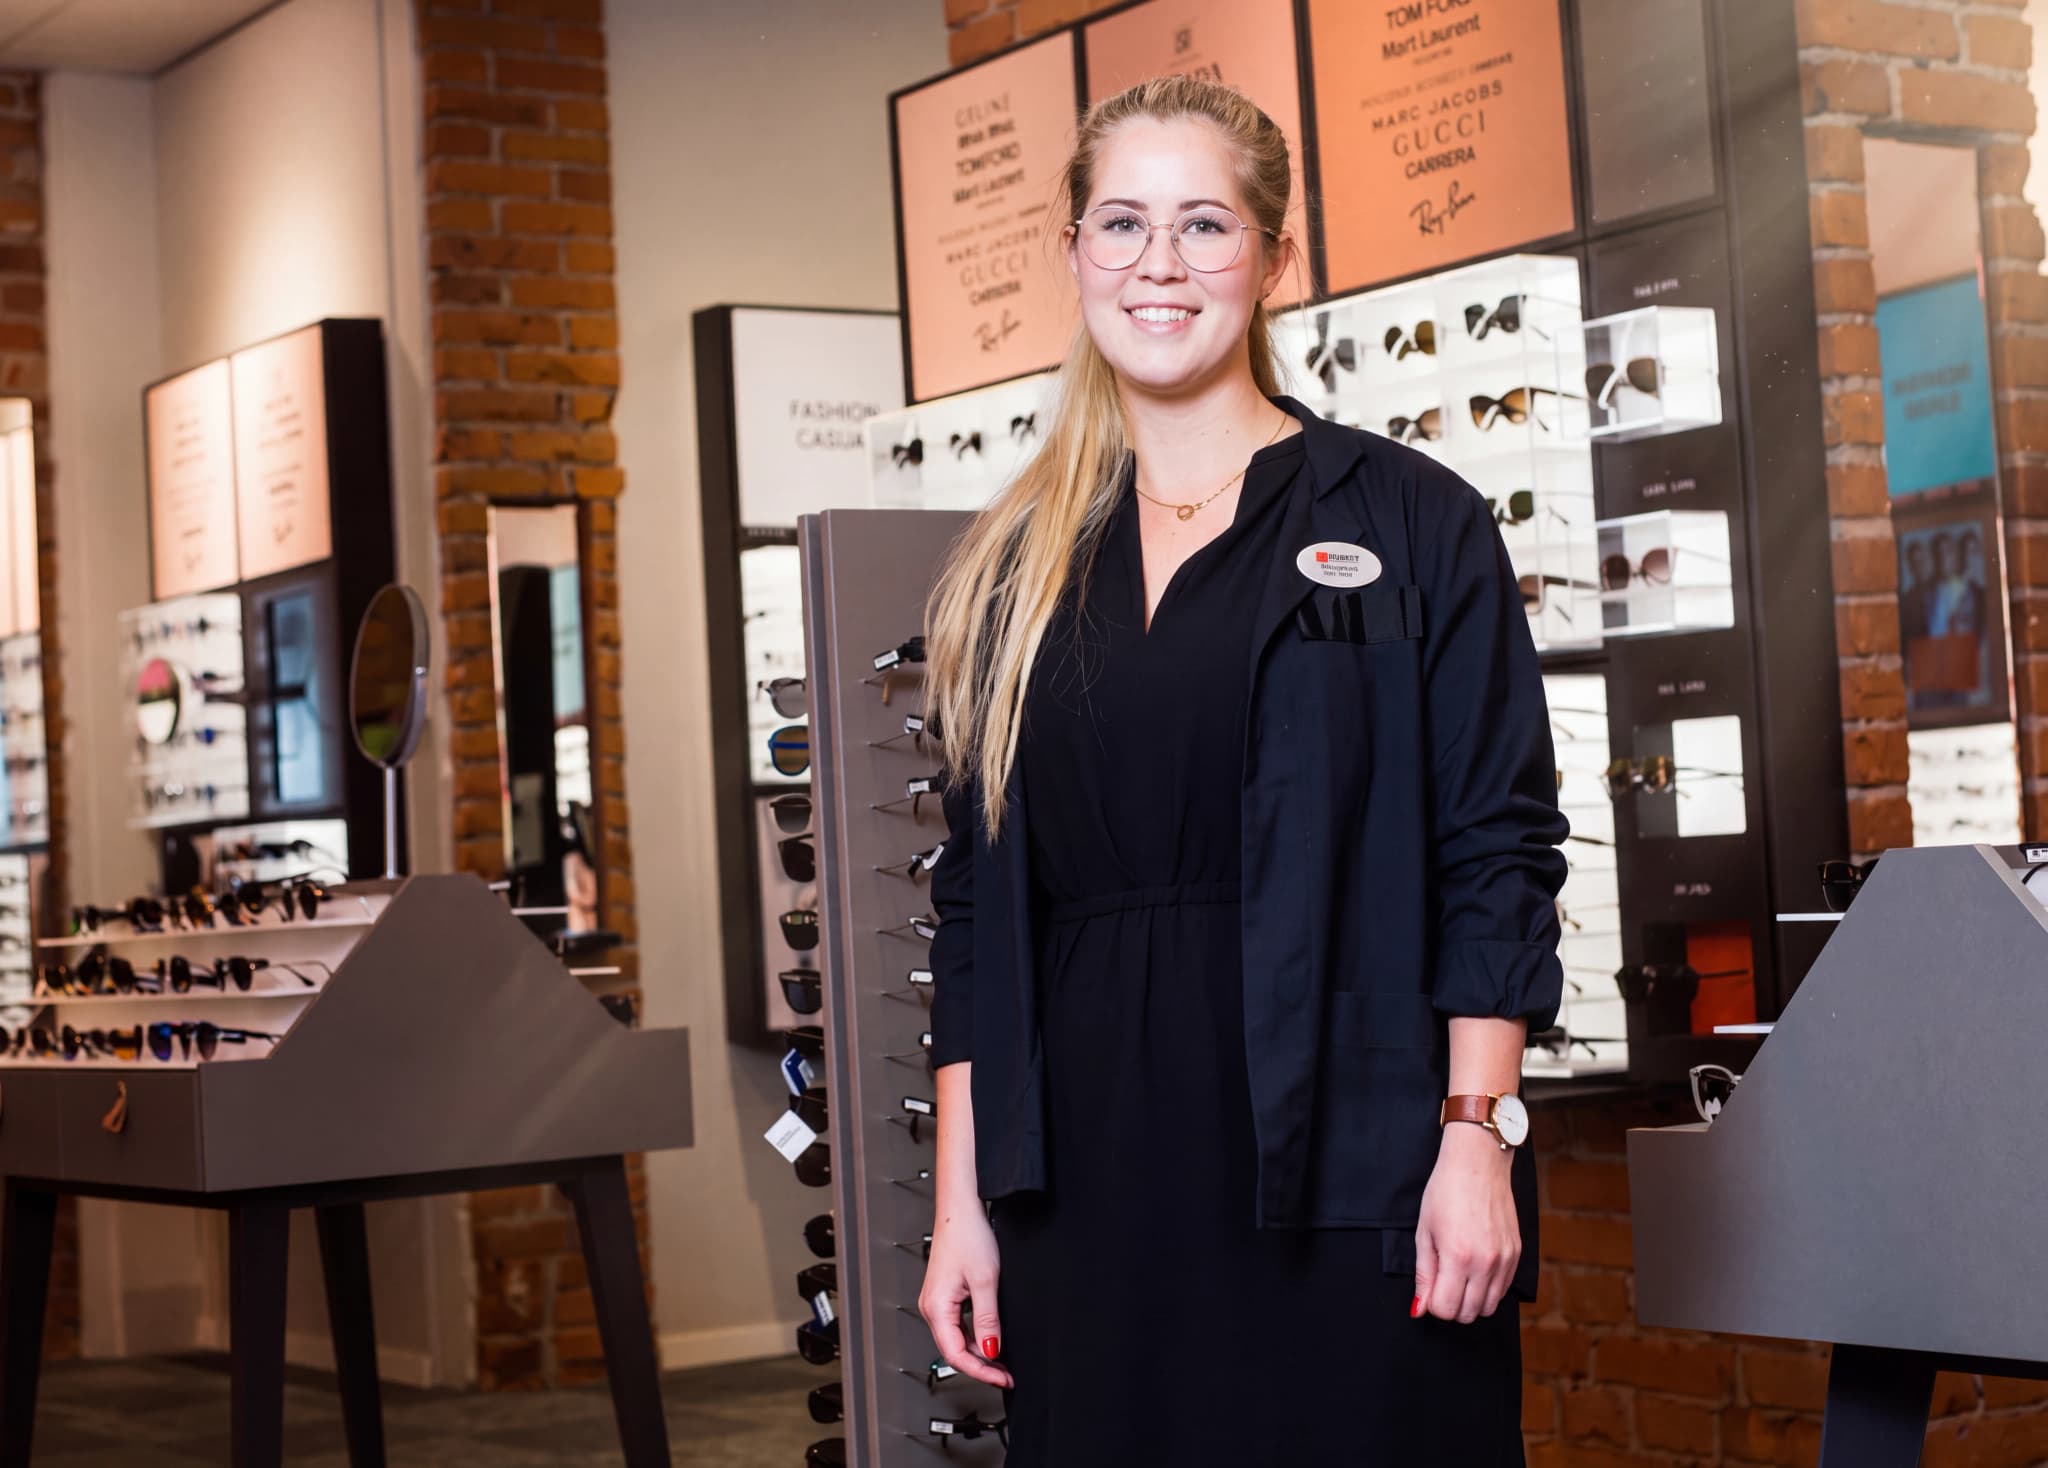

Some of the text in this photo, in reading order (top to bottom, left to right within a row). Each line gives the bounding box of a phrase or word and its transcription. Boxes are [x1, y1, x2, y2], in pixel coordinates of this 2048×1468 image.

[1386, 1, 1422, 30] TOM
[1381, 36, 1417, 60] Mart
[1419, 13, 1481, 48] Laurent
[1372, 104, 1421, 131] MARC
[1428, 79, 1503, 116] JACOBS
[1392, 108, 1486, 158] GUCCI
[1404, 146, 1476, 180] CARRERA
[959, 249, 1029, 288] GUCCI
[790, 399, 880, 422] FASHION
